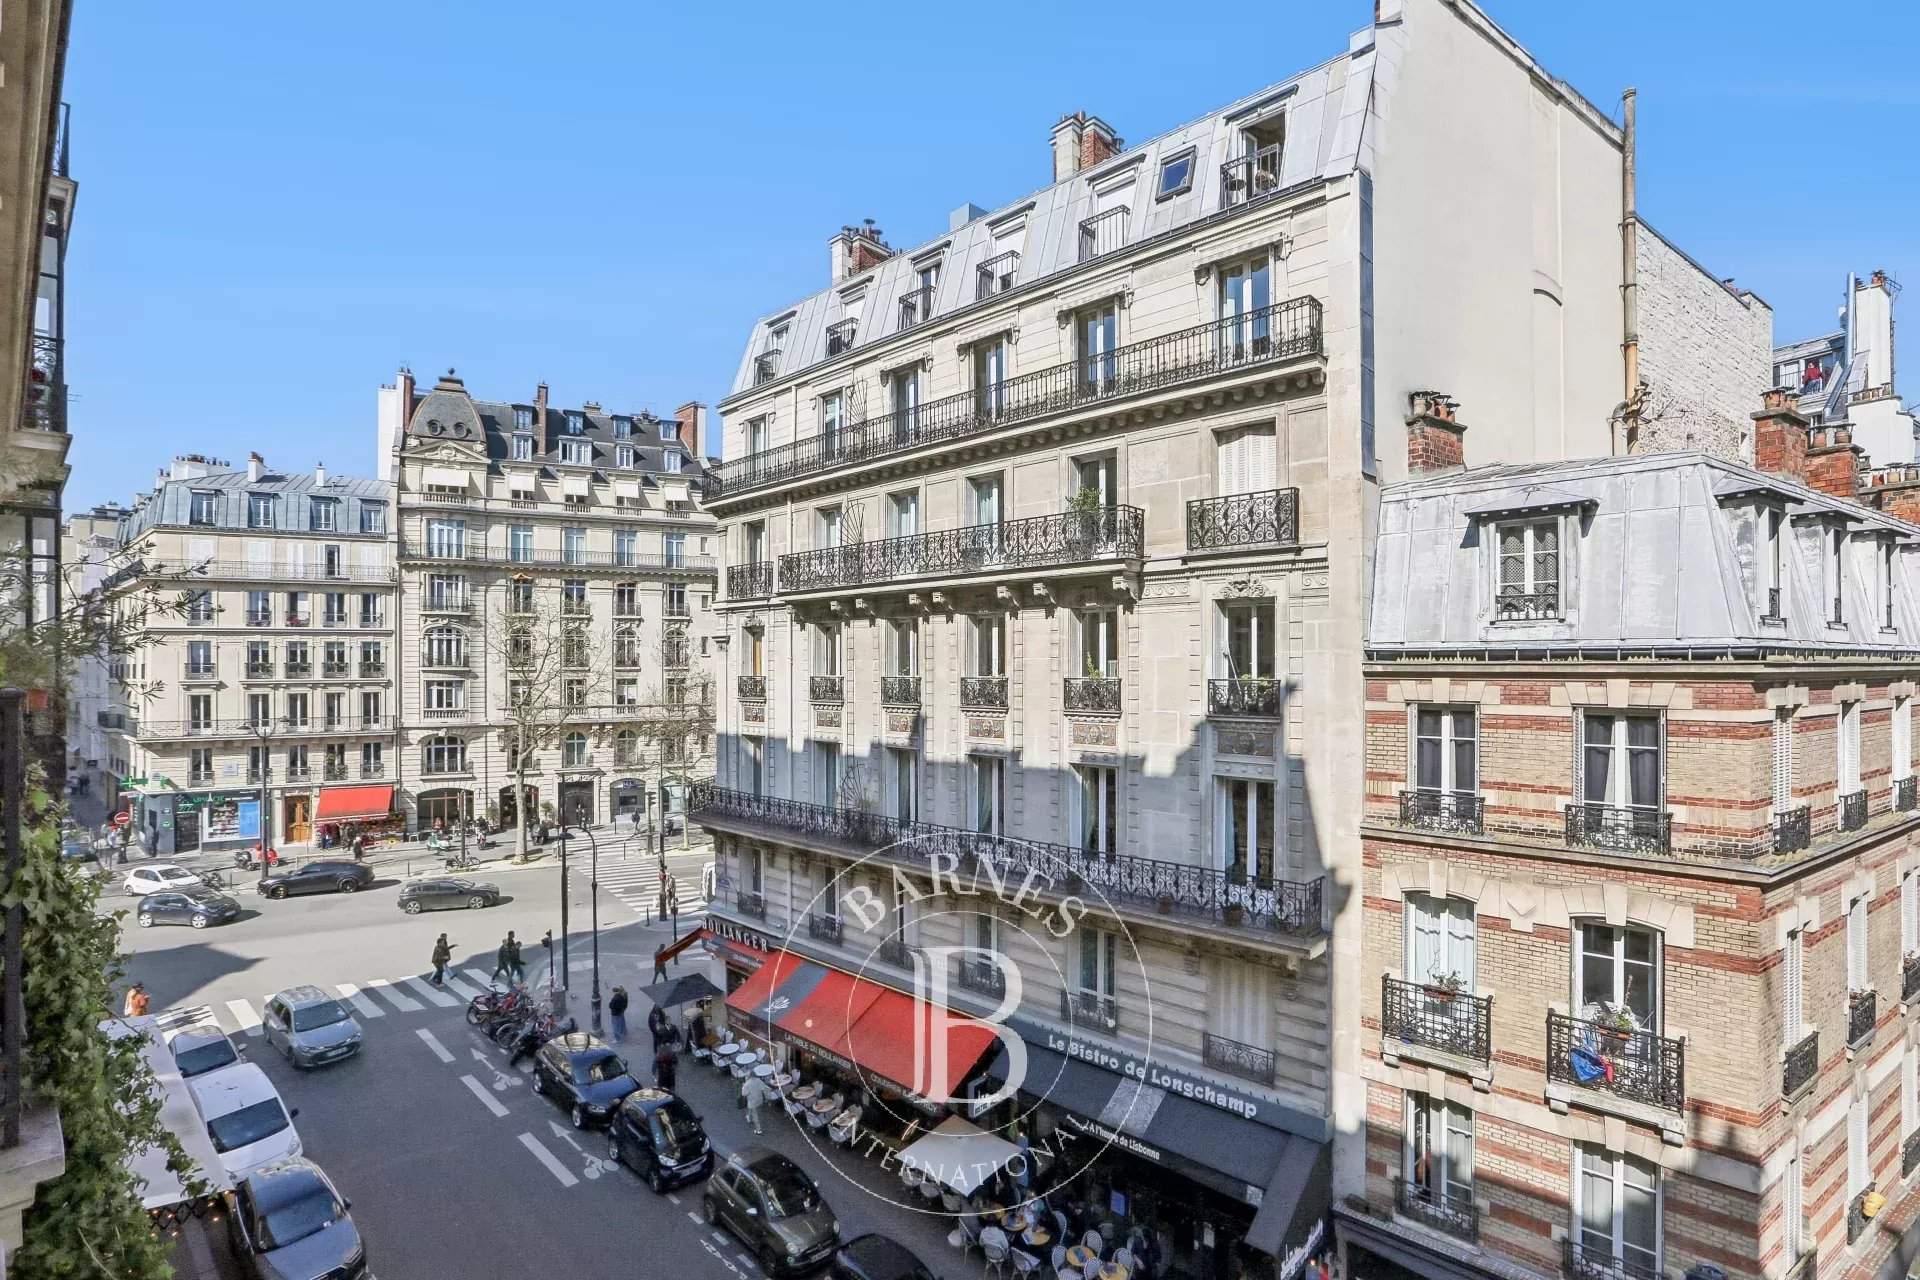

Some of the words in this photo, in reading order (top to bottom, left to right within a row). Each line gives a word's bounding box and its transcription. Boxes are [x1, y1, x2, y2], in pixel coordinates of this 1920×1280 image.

[702, 917, 768, 952] BOULANGER
[1049, 1034, 1064, 1051] Le
[1069, 1041, 1120, 1069] Bistro
[1125, 1061, 1145, 1079] de
[1151, 1069, 1258, 1119] Longchamp
[1129, 1140, 1160, 1160] Lisbonne
